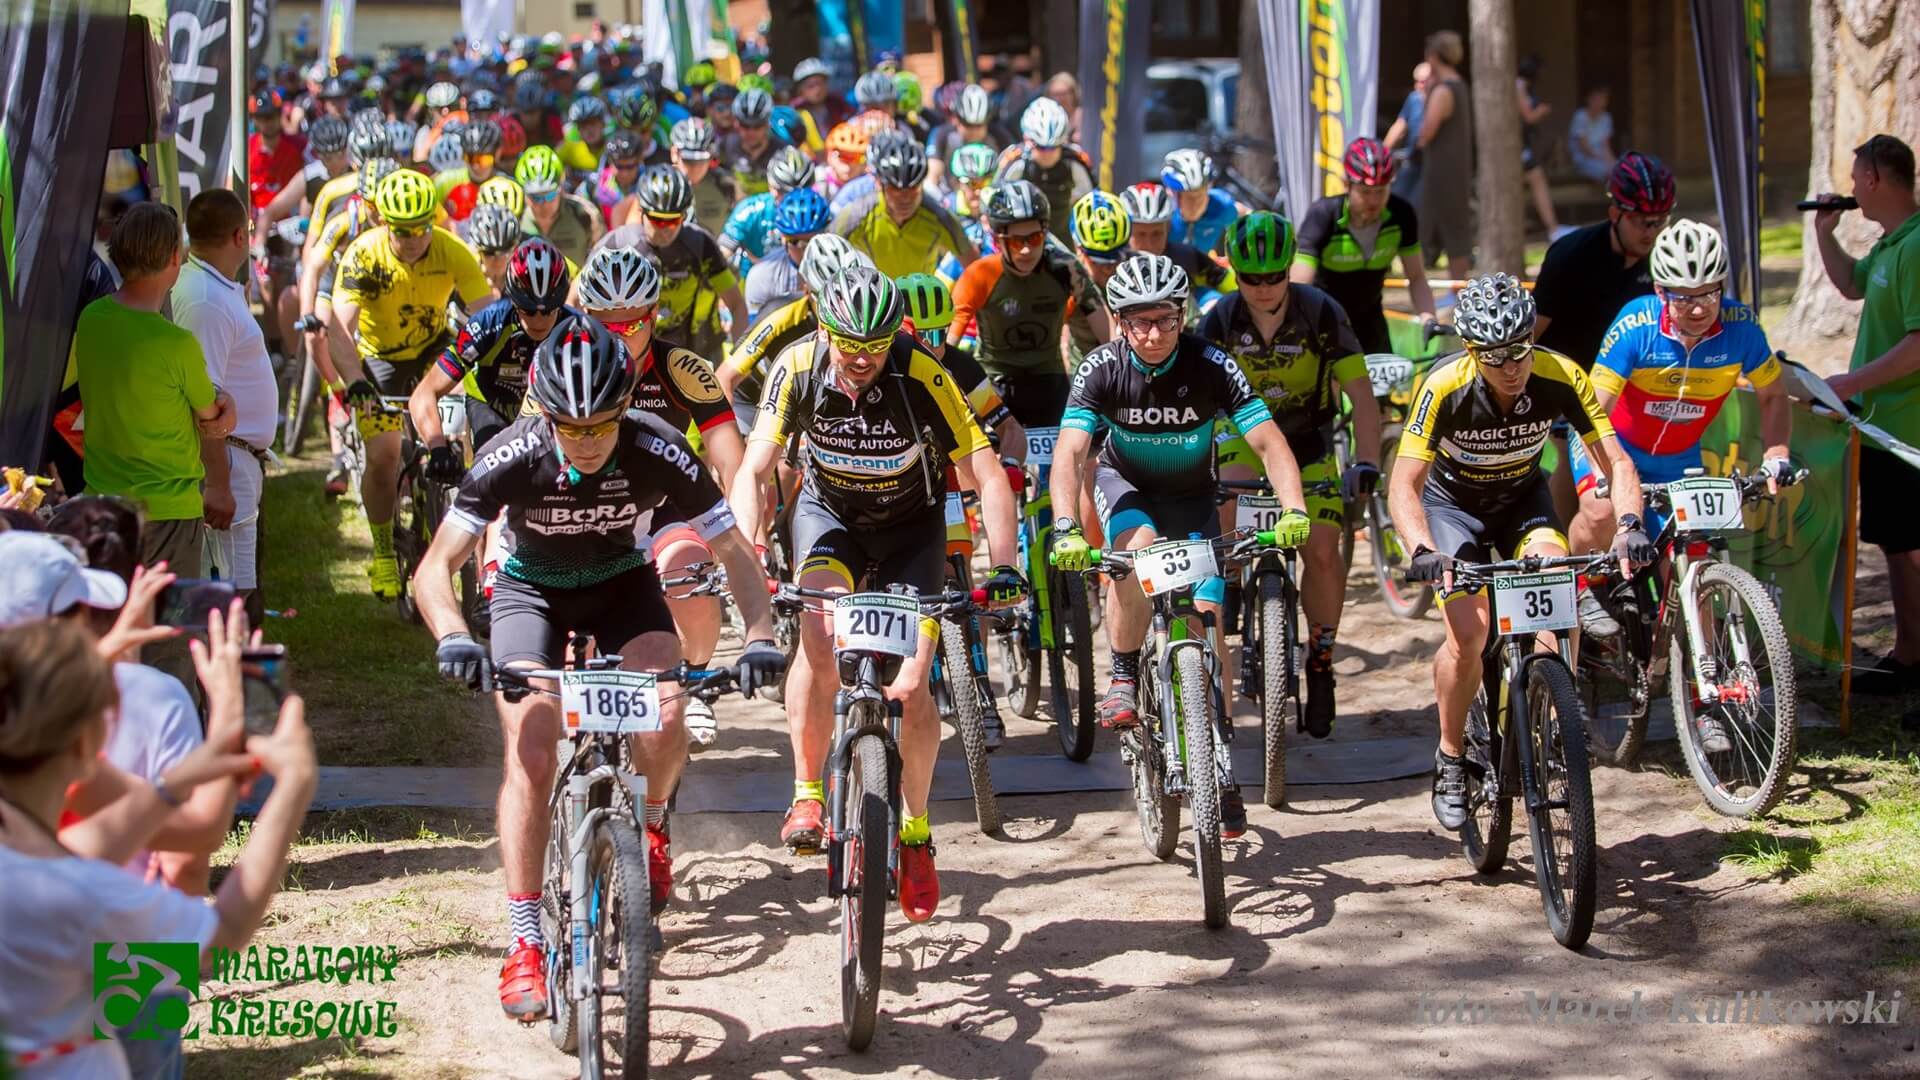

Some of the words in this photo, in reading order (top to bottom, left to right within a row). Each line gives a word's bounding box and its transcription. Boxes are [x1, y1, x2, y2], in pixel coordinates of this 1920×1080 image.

[1600, 309, 1657, 358] MISTRAL
[1074, 349, 1117, 388] BORA
[1128, 407, 1199, 425] BORA
[1454, 427, 1507, 441] MAGIC
[1510, 419, 1553, 437] TEAM
[484, 432, 542, 470] BORA
[650, 436, 701, 483] BORA
[1029, 436, 1058, 455] 69
[551, 503, 638, 524] BORA
[1691, 492, 1724, 516] 197
[1162, 549, 1191, 575] 33
[1524, 589, 1553, 618] 35
[849, 609, 907, 641] 2071
[580, 688, 648, 718] 1865
